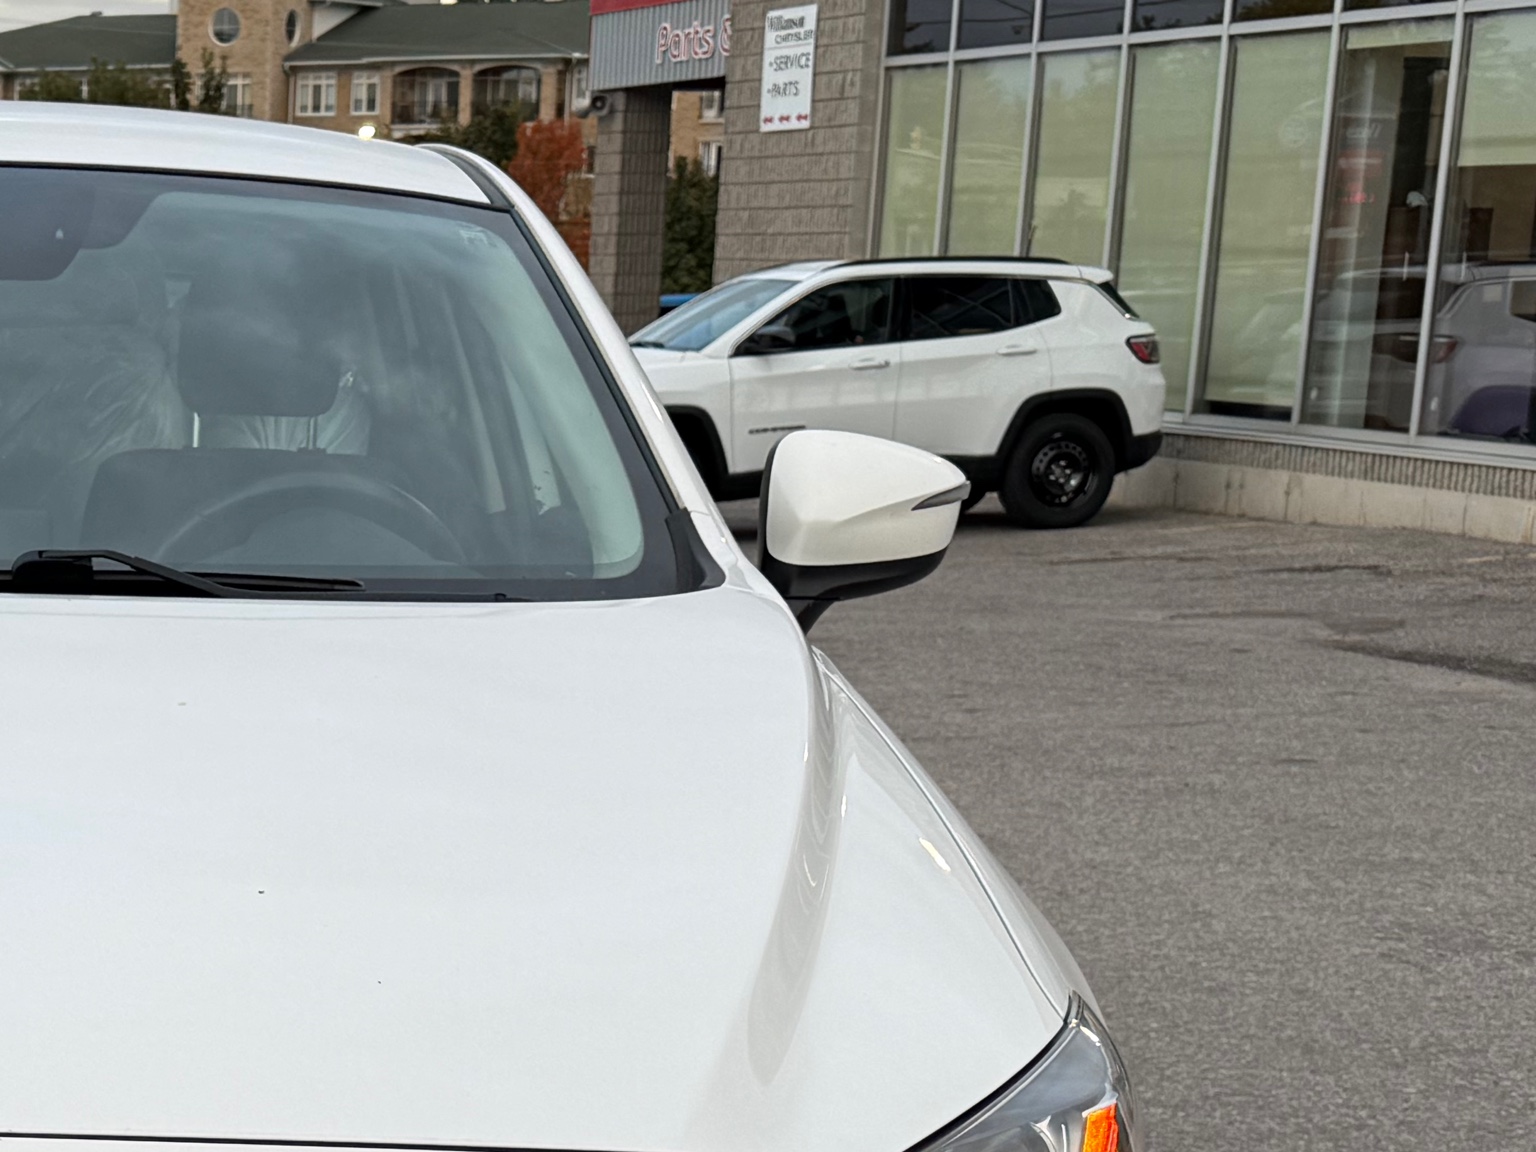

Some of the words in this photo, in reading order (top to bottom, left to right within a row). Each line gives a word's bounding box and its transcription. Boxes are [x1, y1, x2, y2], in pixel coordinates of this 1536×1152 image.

[656, 21, 714, 64] Parts
[773, 52, 811, 72] SERVICE
[771, 81, 800, 98] PARTS
